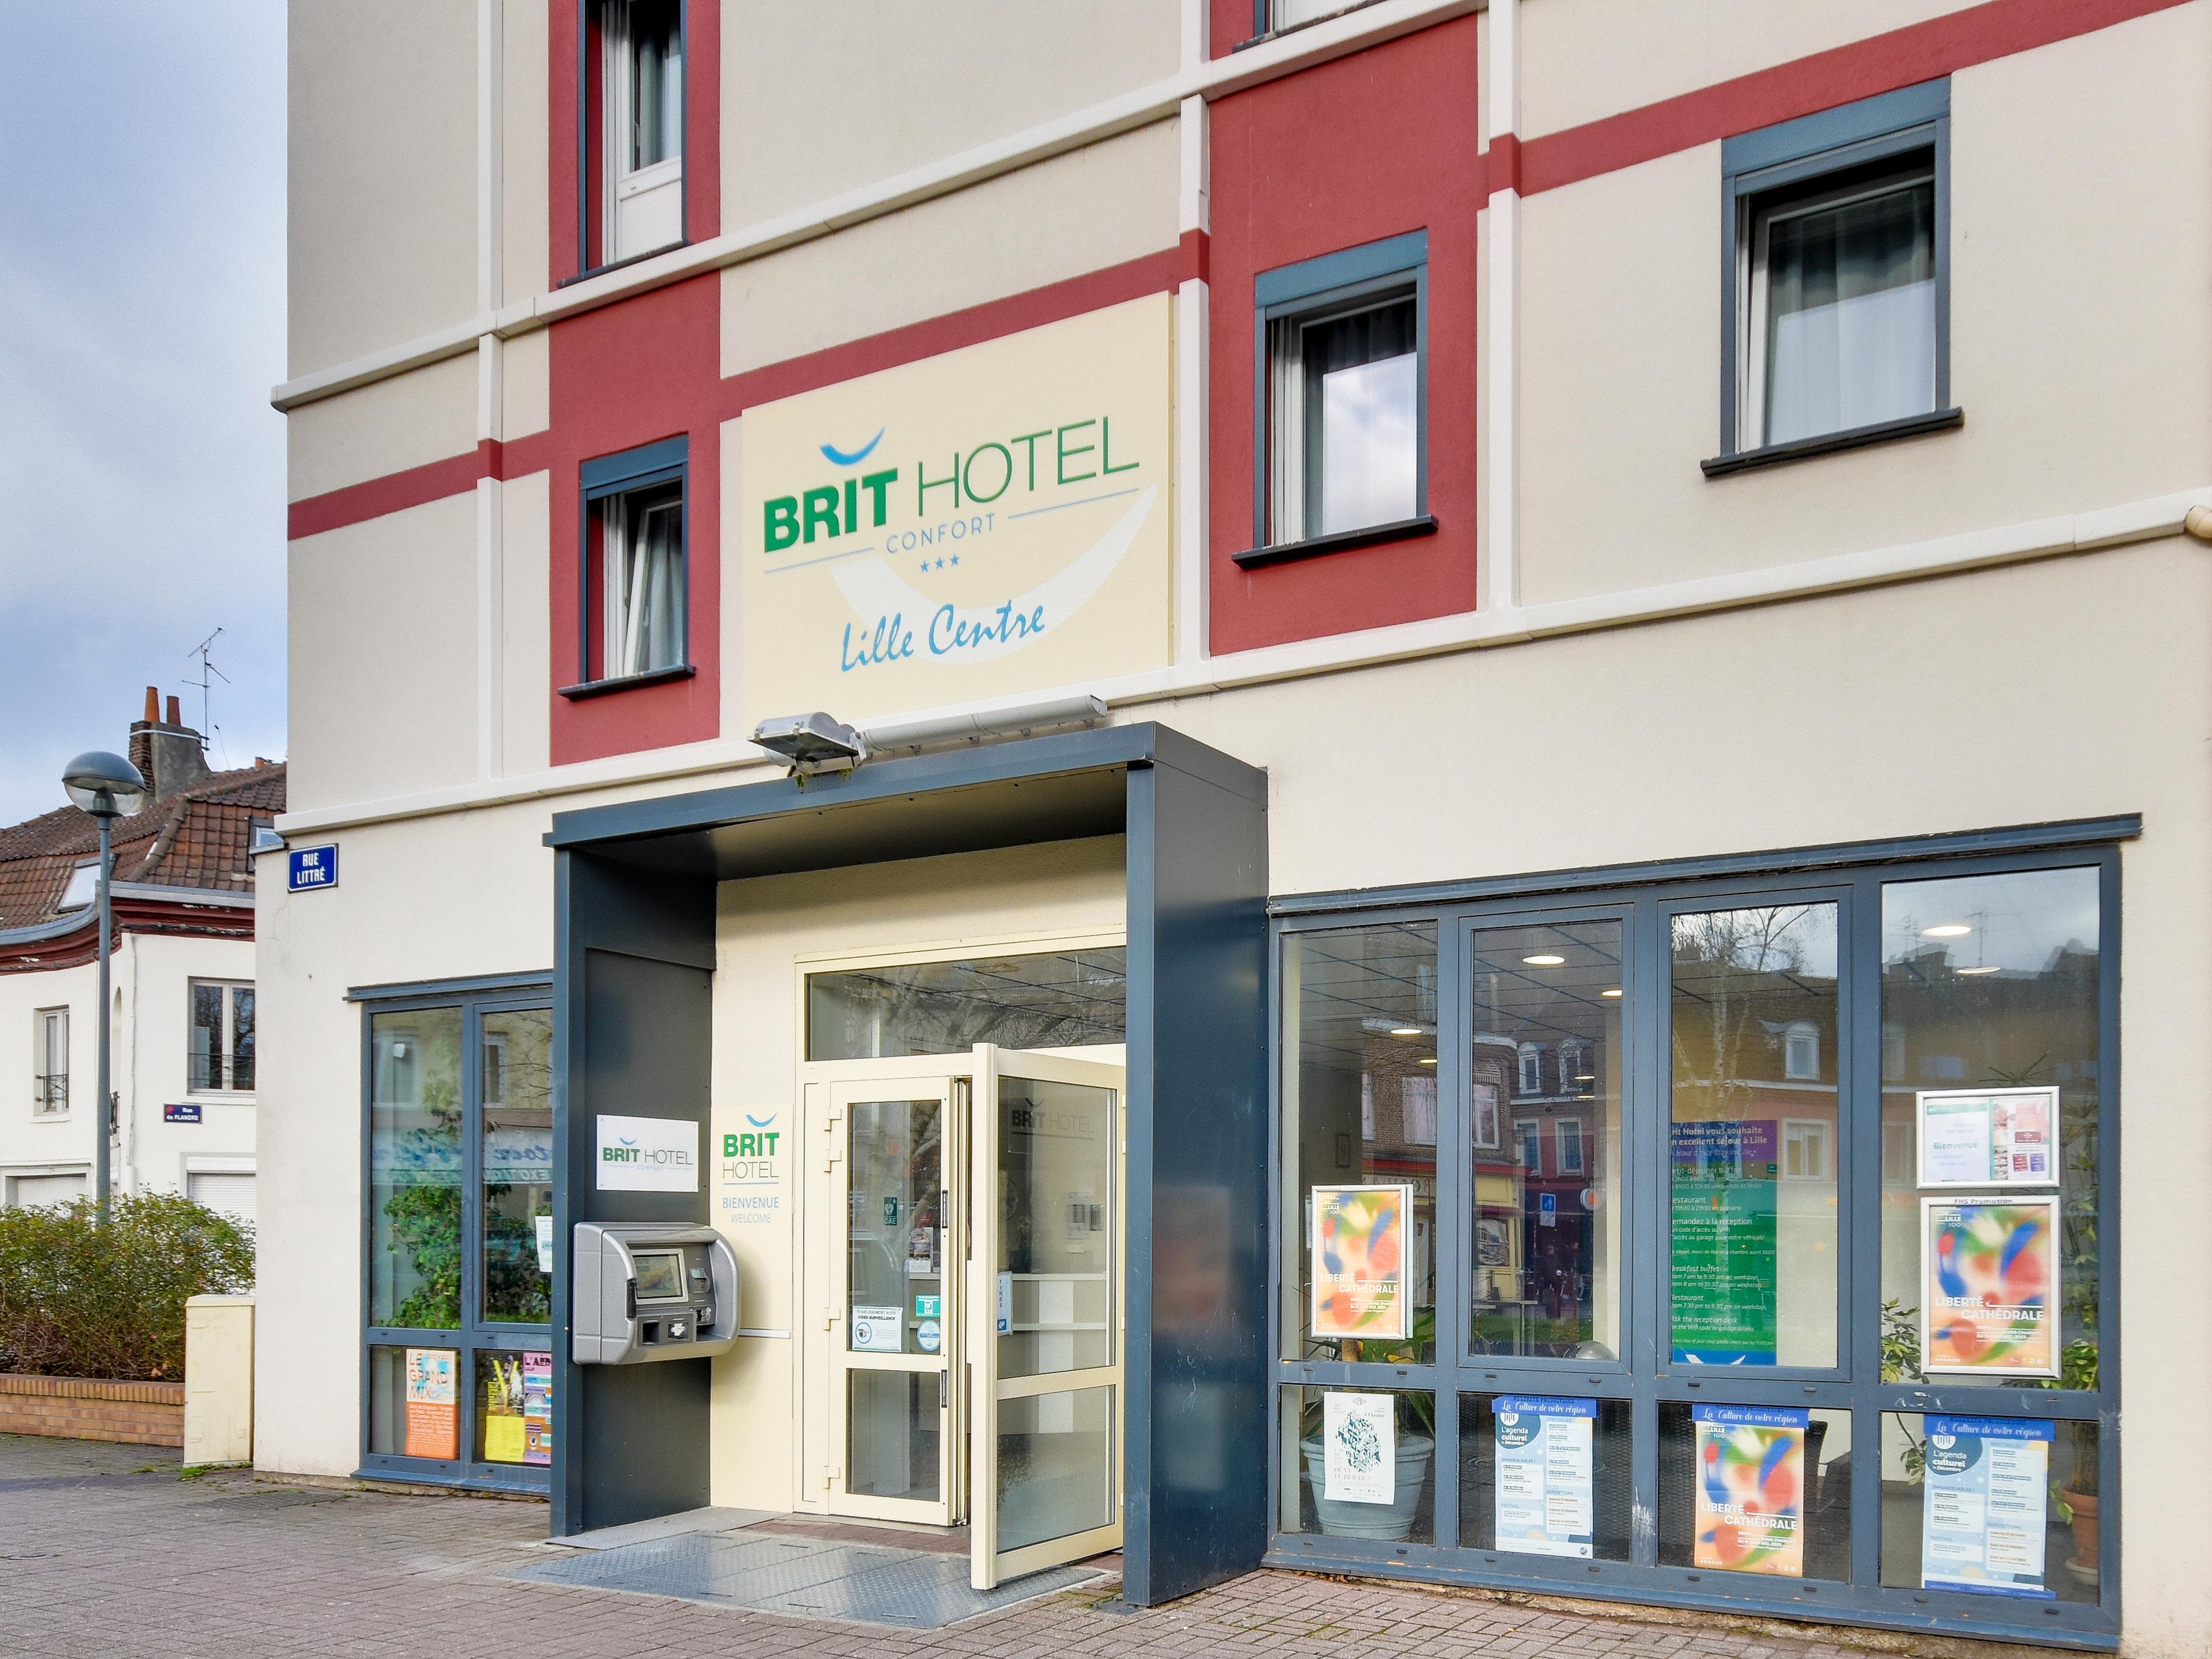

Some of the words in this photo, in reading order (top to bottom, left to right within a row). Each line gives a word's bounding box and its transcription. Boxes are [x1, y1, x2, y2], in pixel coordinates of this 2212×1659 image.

[764, 468, 897, 553] BRIT
[918, 416, 1139, 517] HOTEL
[886, 513, 995, 554] CONFORT
[841, 613, 914, 672] Lille
[928, 600, 1046, 655] Centre
[302, 853, 319, 867] RUE
[297, 866, 325, 884] LITTRÉ
[1012, 1109, 1045, 1129] BRIT
[1049, 1112, 1094, 1134] HOTEL
[1672, 1127, 1681, 1136] rit
[1683, 1127, 1705, 1135] Hotel
[1726, 1126, 1763, 1135] souhaite
[723, 1132, 779, 1157] BRIT
[1679, 1137, 1714, 1146] excellent
[1750, 1136, 1768, 1144] Lille
[1933, 1142, 1979, 1150] Bienvenue
[603, 1147, 640, 1162] BRIT
[645, 1149, 693, 1165] HOTEL
[722, 1161, 779, 1179] HOTEL
[1672, 1166, 1717, 1176] etit-déjeuner
[722, 1197, 779, 1209] BIENVENUE
[730, 1213, 771, 1224] WELCOME
[884, 1217, 897, 1225] DAE
[1719, 1218, 1752, 1226] réception
[1700, 1264, 1719, 1273] buffet
[1320, 1272, 1355, 1283] LIBERTÉ
[1338, 1283, 1399, 1294] CATHÉDRALE
[1935, 1296, 1984, 1306] LIBERTÉ
[1961, 1308, 2044, 1320] CATHÉDRALE
[410, 1353, 422, 1366] LE
[409, 1369, 448, 1384] GRAND
[410, 1385, 432, 1400] MIX
[1502, 1400, 1512, 1412] La
[1515, 1400, 1537, 1411] Culture
[1539, 1403, 1546, 1411] de
[1565, 1405, 1586, 1415] région
[1703, 1408, 1715, 1421] La
[1718, 1409, 1742, 1421] Culture
[1745, 1412, 1753, 1421] de
[1755, 1414, 1772, 1422] votre
[1774, 1414, 1798, 1426] région
[1501, 1426, 1528, 1434] L'agenda
[1935, 1421, 1948, 1435] La
[1952, 1422, 1979, 1434] Culture
[1982, 1425, 1991, 1434] de
[1993, 1426, 2013, 1435] votre
[2015, 1427, 2042, 1438] région
[1933, 1450, 1967, 1460] L'agenda
[1933, 1459, 1965, 1468] culturel
[1702, 1502, 1744, 1514] LIBERTÉ
[1724, 1515, 1798, 1531] CATHÉDRALE
